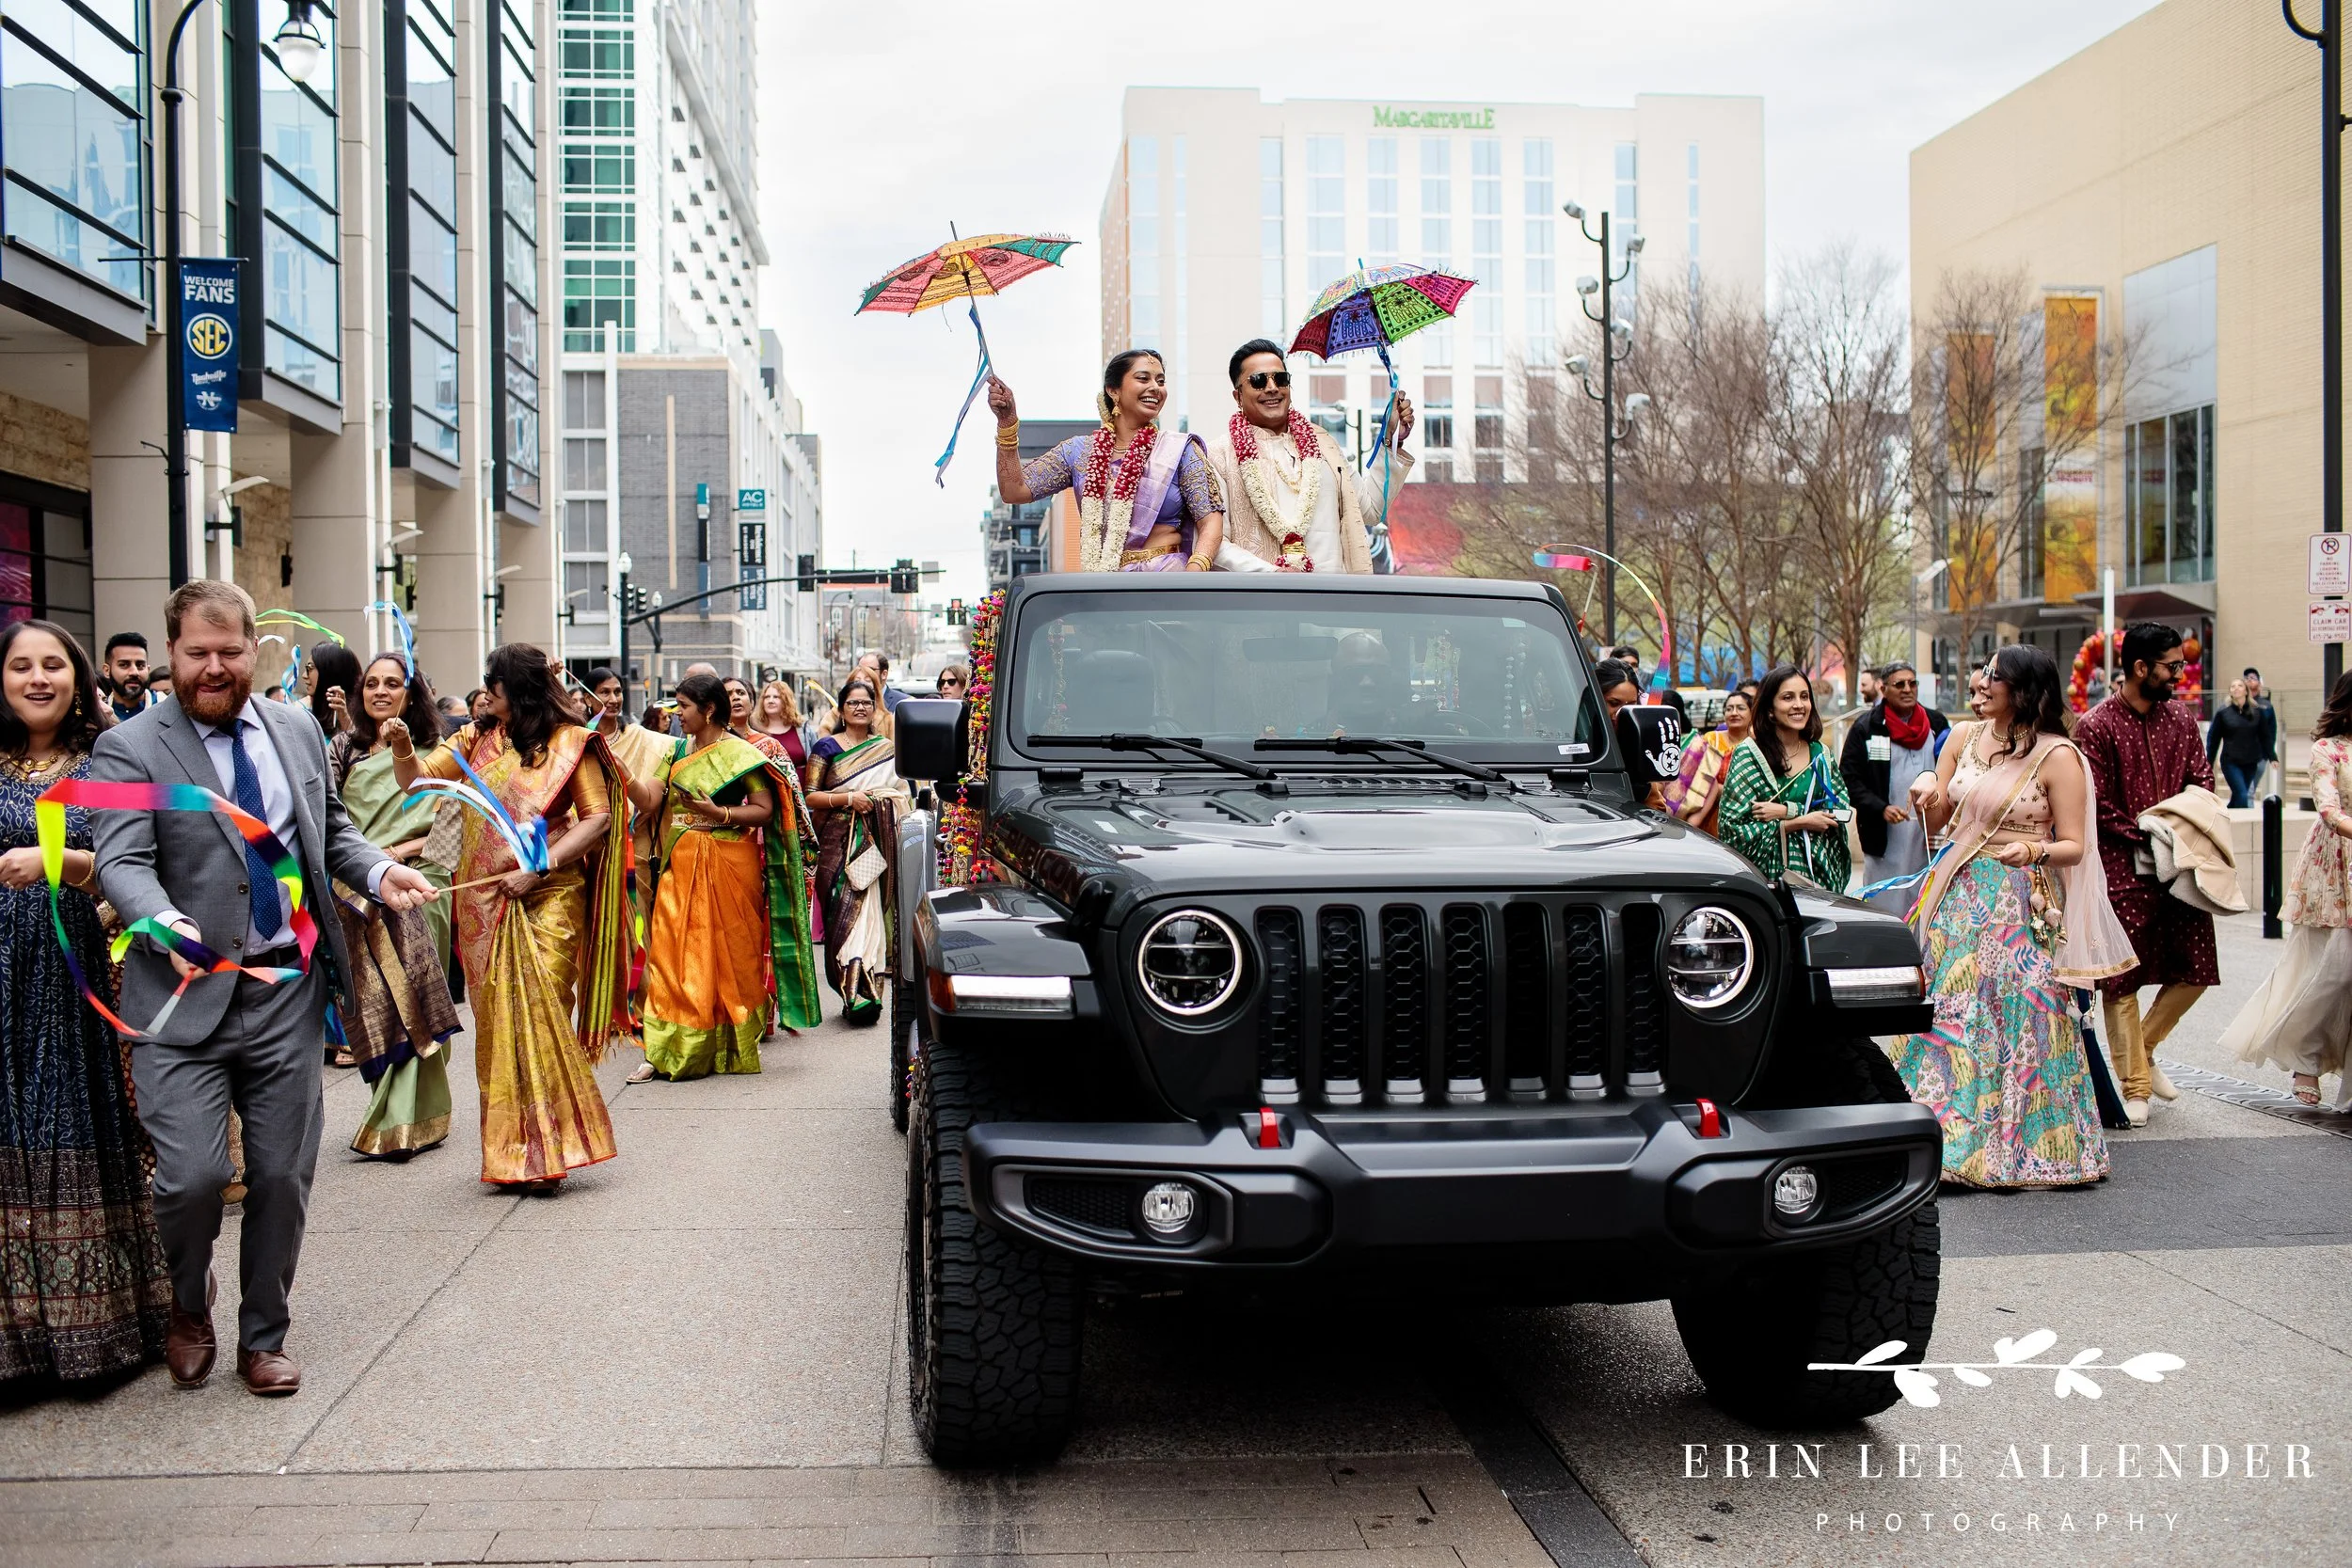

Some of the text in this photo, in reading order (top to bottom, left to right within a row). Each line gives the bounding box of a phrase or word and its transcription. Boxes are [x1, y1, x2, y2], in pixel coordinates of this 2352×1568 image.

[1373, 105, 1496, 130] MARGARITAVILLE
[183, 276, 234, 288] WELCOME
[184, 284, 235, 304] FANS
[191, 319, 228, 356] SEC
[741, 491, 764, 503] AC
